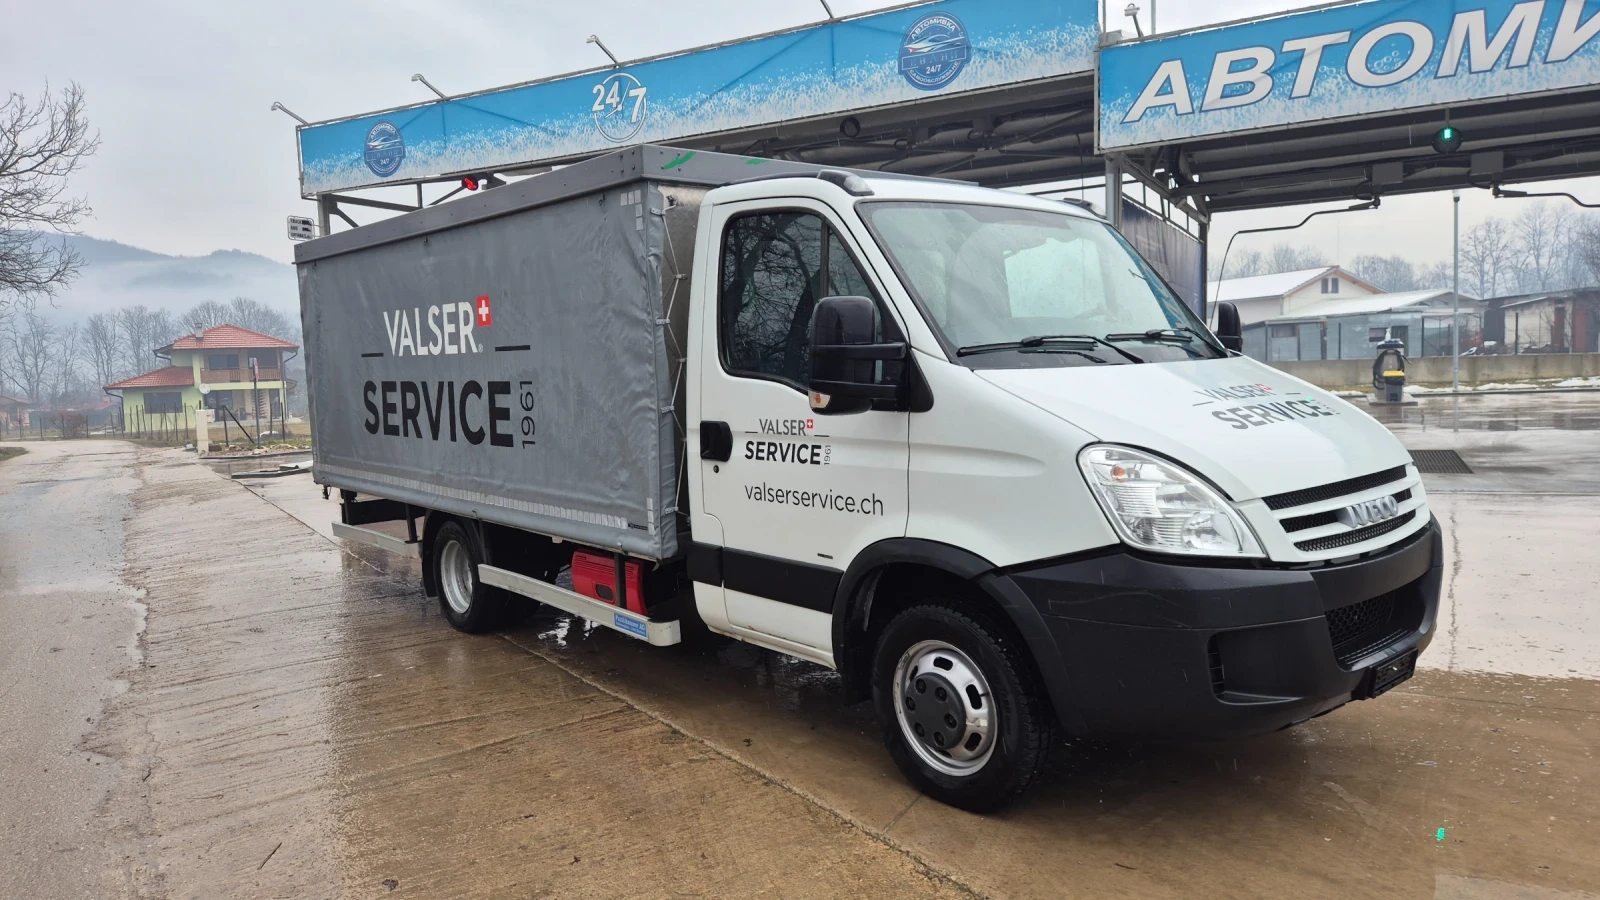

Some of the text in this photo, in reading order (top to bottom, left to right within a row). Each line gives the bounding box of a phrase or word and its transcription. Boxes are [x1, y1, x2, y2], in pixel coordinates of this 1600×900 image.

[911, 18, 956, 40] АВТОМИВКА
[926, 64, 942, 74] 24/7
[1194, 384, 1276, 401] VALSER
[363, 379, 514, 448] SERVICE
[519, 381, 536, 449] 1961
[1211, 399, 1334, 430] SERVICE
[759, 418, 807, 436] VALSER
[744, 440, 822, 465] SERVICE
[824, 445, 832, 465] 1961
[744, 482, 884, 516] valserservice.ch
[1342, 495, 1399, 529] IVECO
